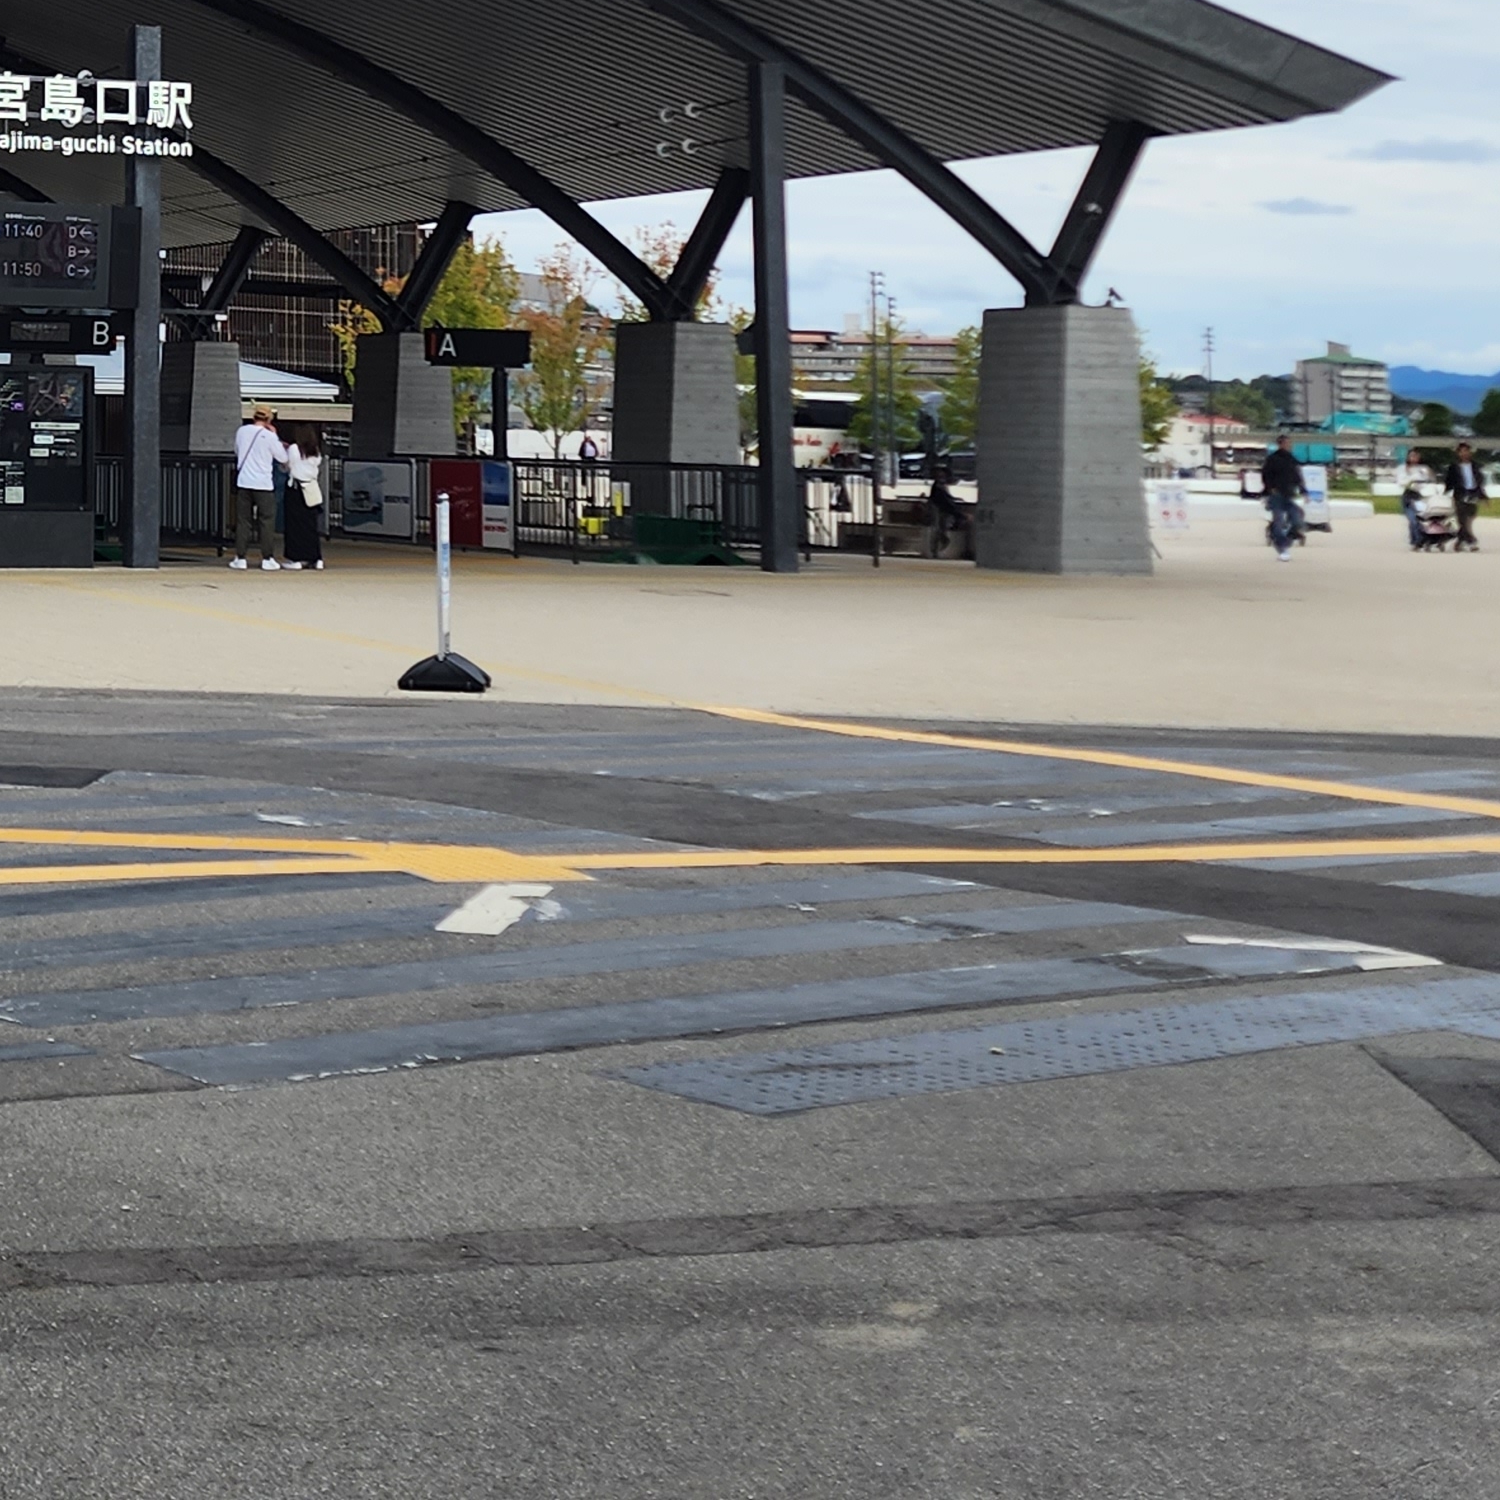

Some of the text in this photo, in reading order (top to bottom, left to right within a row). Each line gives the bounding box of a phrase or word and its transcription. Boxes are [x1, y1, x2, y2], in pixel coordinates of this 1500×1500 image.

[121, 135, 193, 157] Station
[4, 223, 43, 238] 11:40
[69, 226, 77, 238] D
[68, 246, 76, 258] B
[3, 262, 41, 276] 11:50
[67, 264, 75, 277] C
[92, 321, 109, 345] B
[438, 333, 457, 357] A
